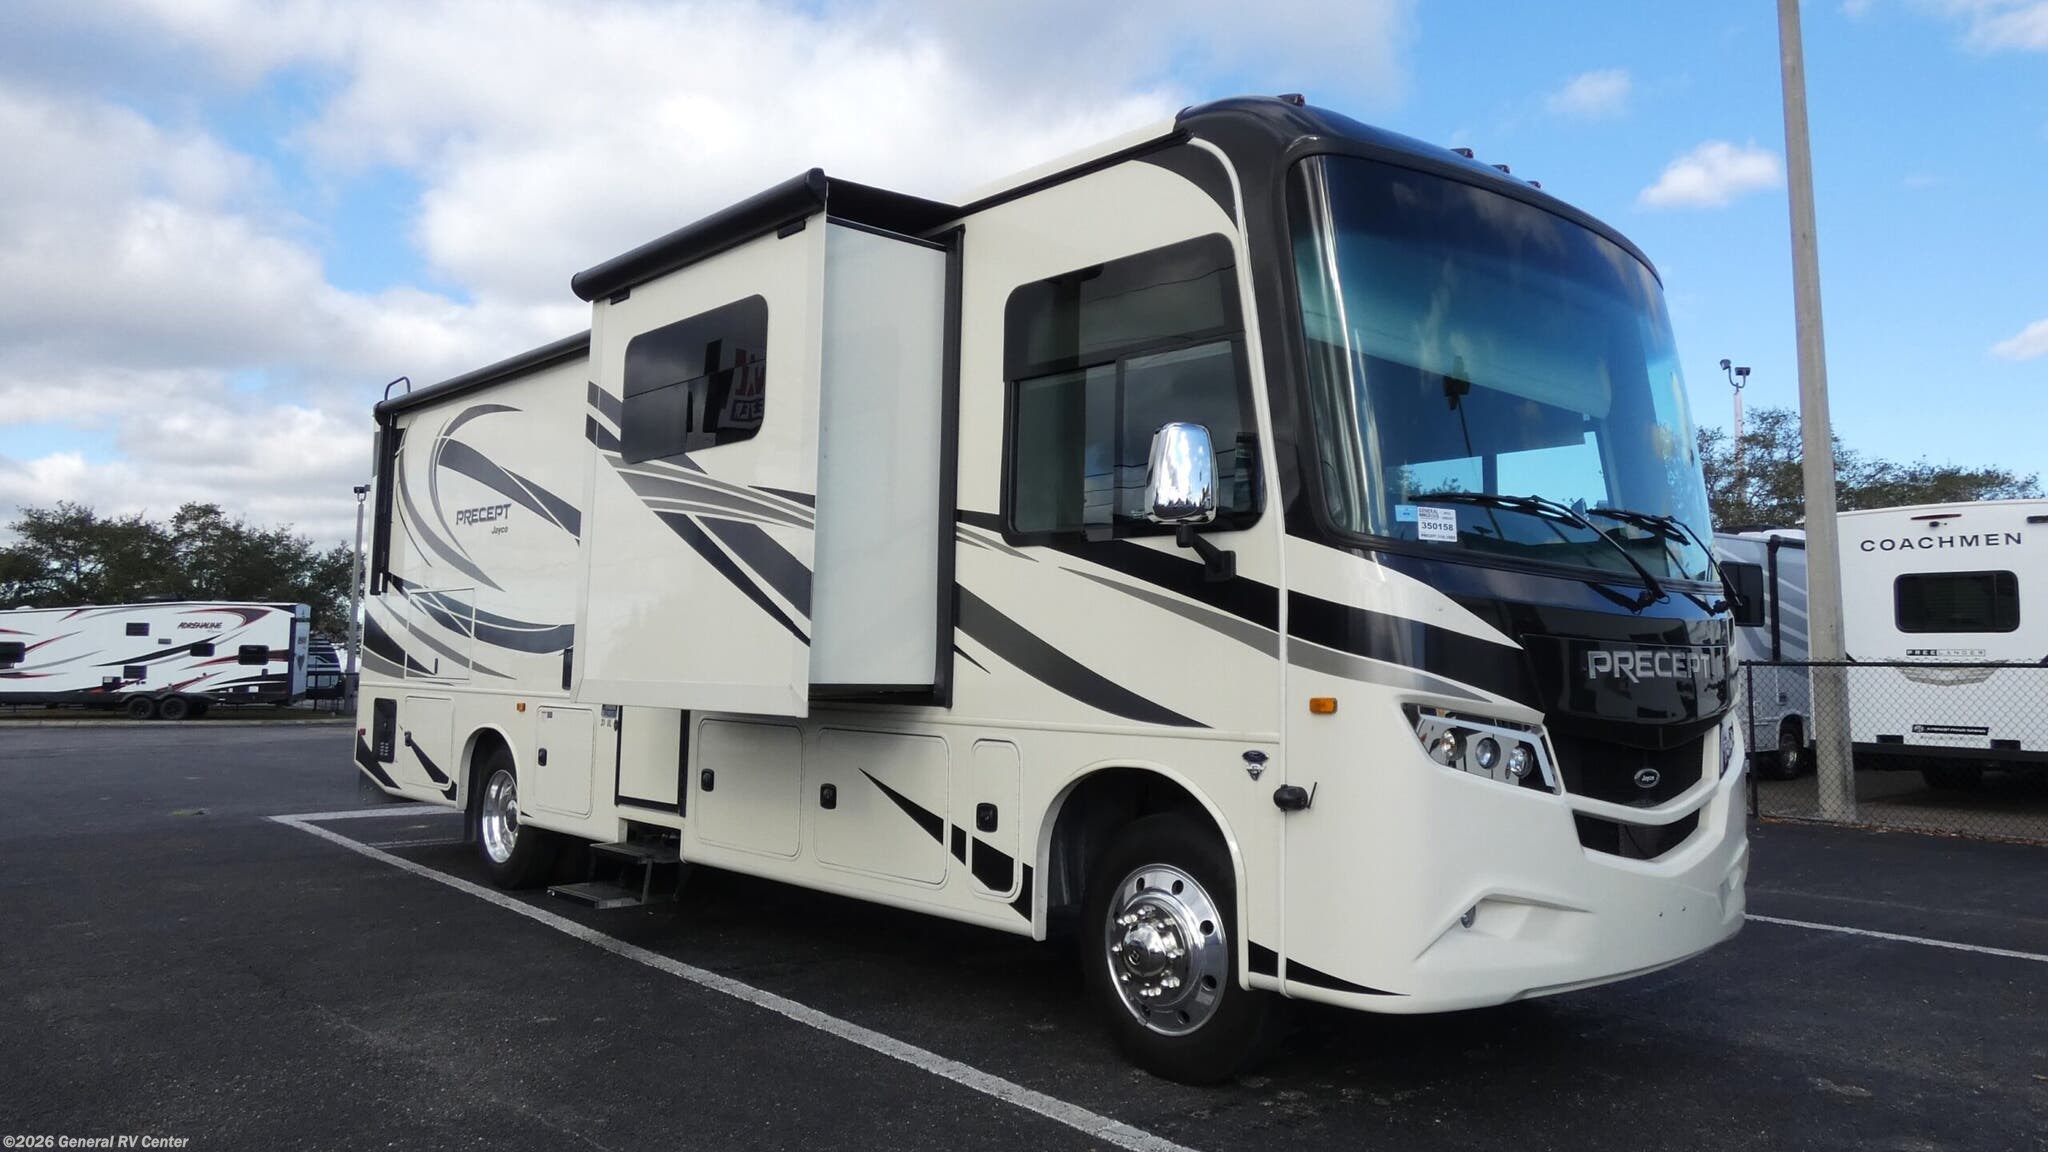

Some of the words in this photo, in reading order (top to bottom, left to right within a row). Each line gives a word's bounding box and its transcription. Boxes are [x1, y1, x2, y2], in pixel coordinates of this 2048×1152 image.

[456, 503, 512, 525] PRECEPT
[491, 525, 508, 535] Jayco
[1421, 521, 1454, 532] 350158
[1860, 532, 2022, 552] COACHMEN
[1587, 650, 1711, 684] PRECEPT
